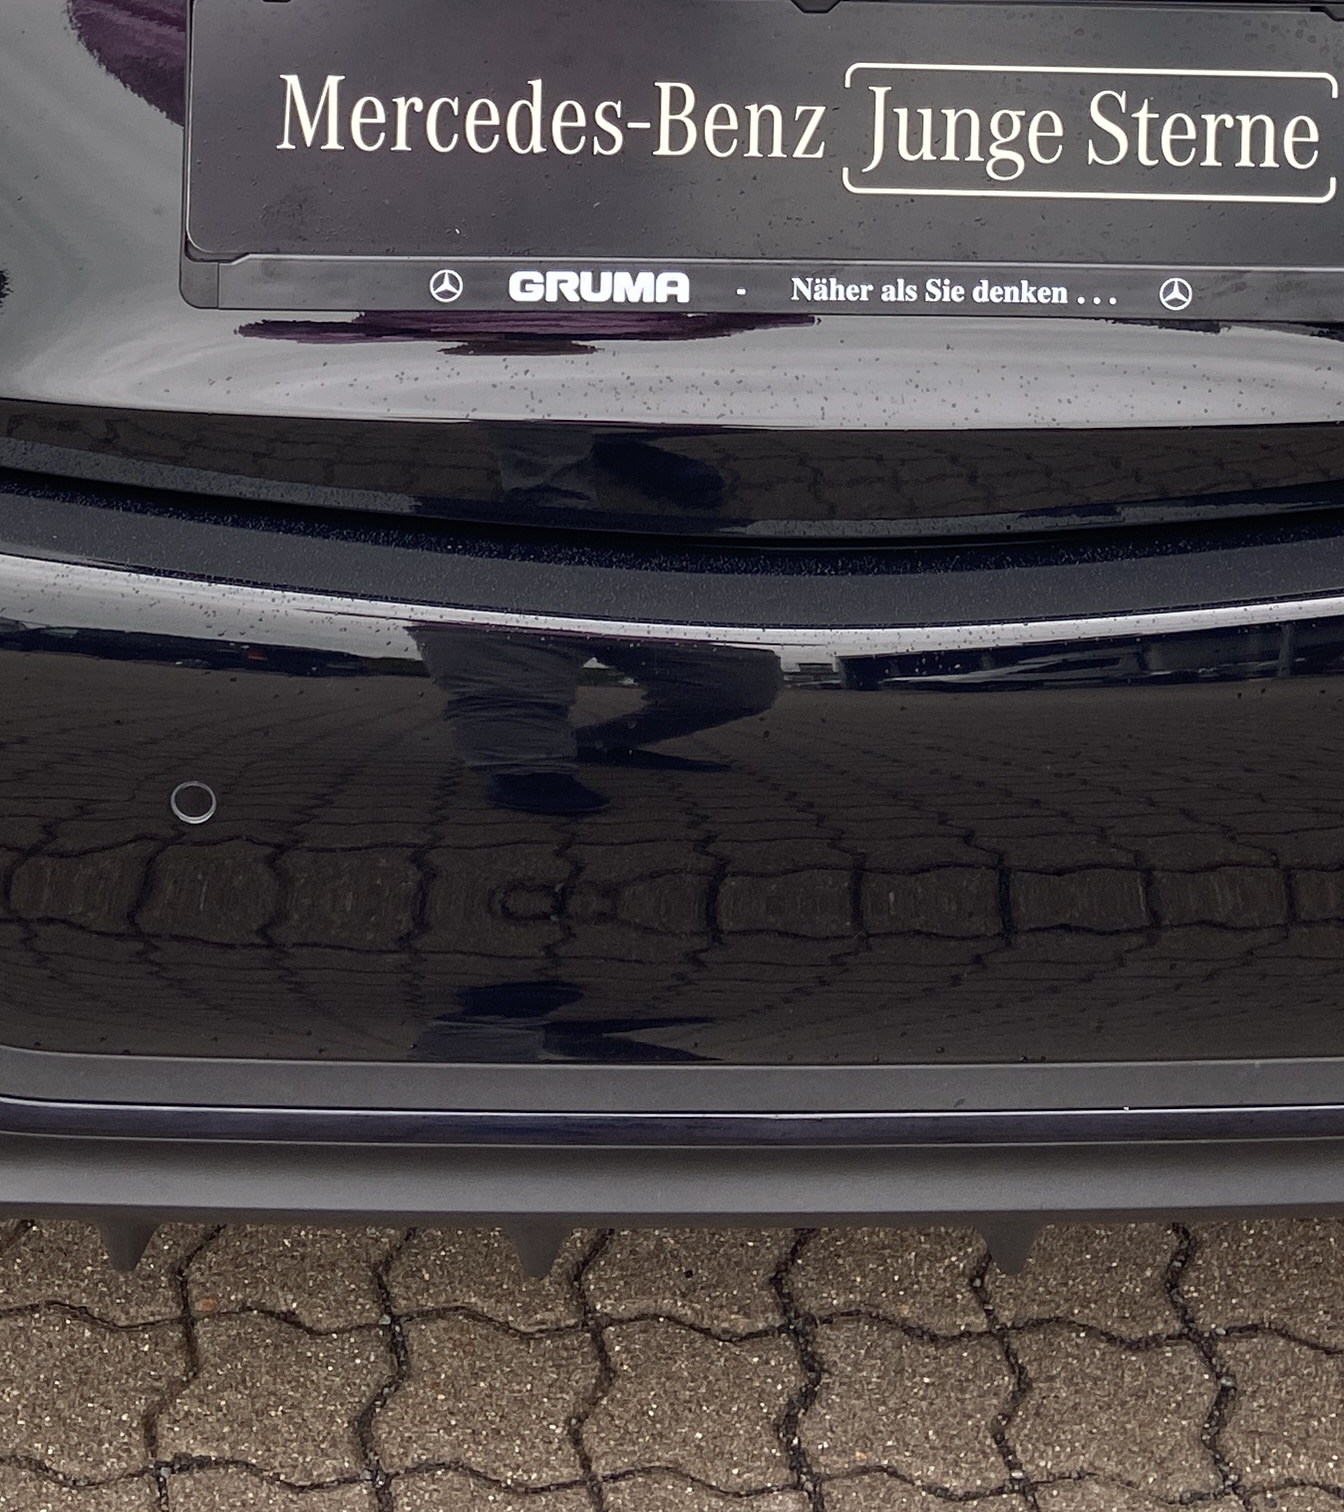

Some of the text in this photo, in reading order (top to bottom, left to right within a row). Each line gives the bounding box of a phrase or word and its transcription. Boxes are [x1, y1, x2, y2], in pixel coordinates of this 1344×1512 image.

[275, 73, 1320, 181] Mercedes-Benz Junge Sterne
[508, 270, 690, 304] GRUMA
[790, 276, 875, 303] Näher
[880, 277, 919, 303] als
[923, 277, 966, 304] Sie
